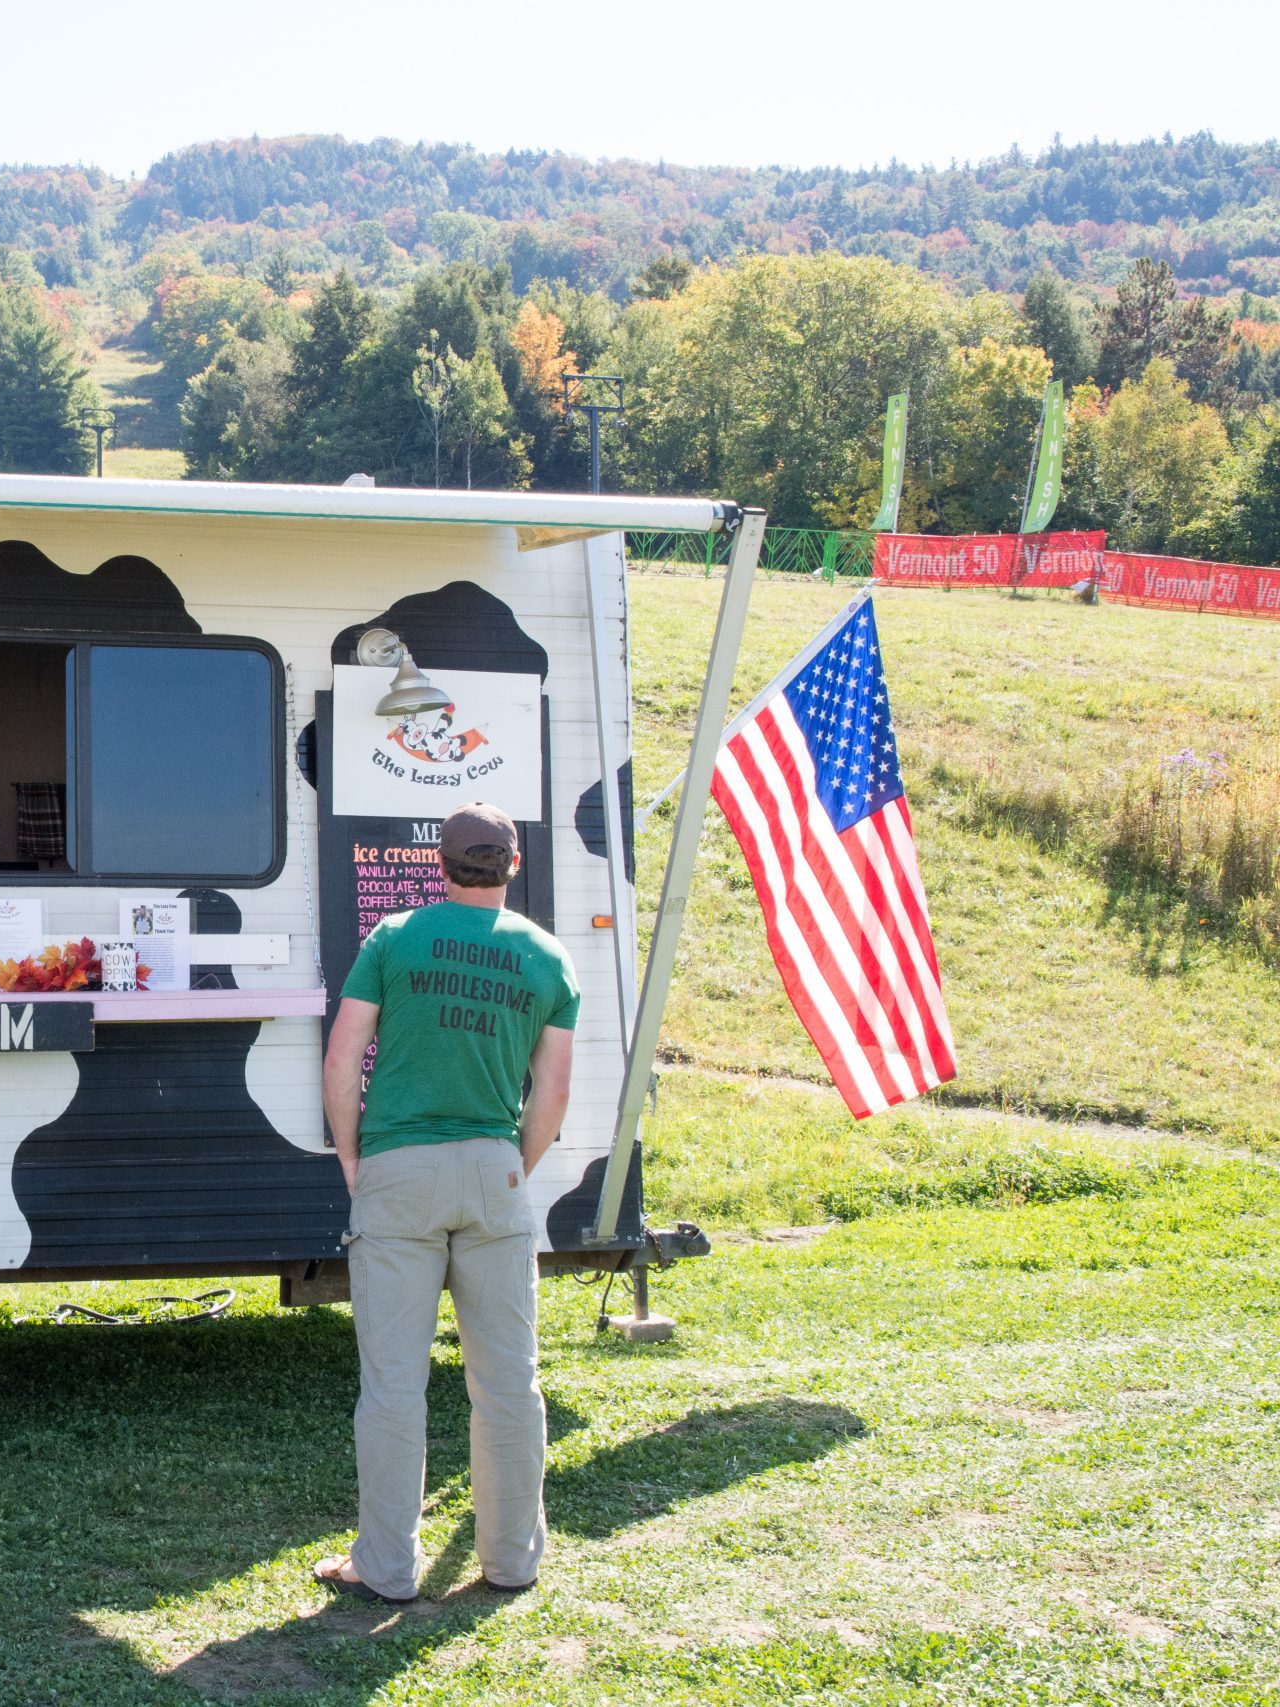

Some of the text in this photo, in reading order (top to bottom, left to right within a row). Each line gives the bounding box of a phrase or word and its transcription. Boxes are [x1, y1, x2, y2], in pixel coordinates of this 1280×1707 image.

[883, 409, 902, 517] FINISH
[1036, 398, 1060, 518] FINISH
[888, 543, 999, 577] Vermont 50
[1024, 544, 1104, 576] Vermon
[1144, 566, 1238, 604] Vermont 50
[371, 748, 504, 786] The Lazy Cow
[412, 822, 441, 842] ME
[353, 843, 440, 864] ice cream
[357, 865, 442, 878] VANILLA MOCHA
[357, 881, 415, 893] CHOCOLATE
[357, 896, 398, 908] COFFEE
[405, 894, 425, 907] SEA
[106, 955, 131, 966] COW
[432, 938, 523, 976] ORIGINAL
[409, 970, 536, 1015] WHOLESOME
[438, 1005, 497, 1037] LOCAL
